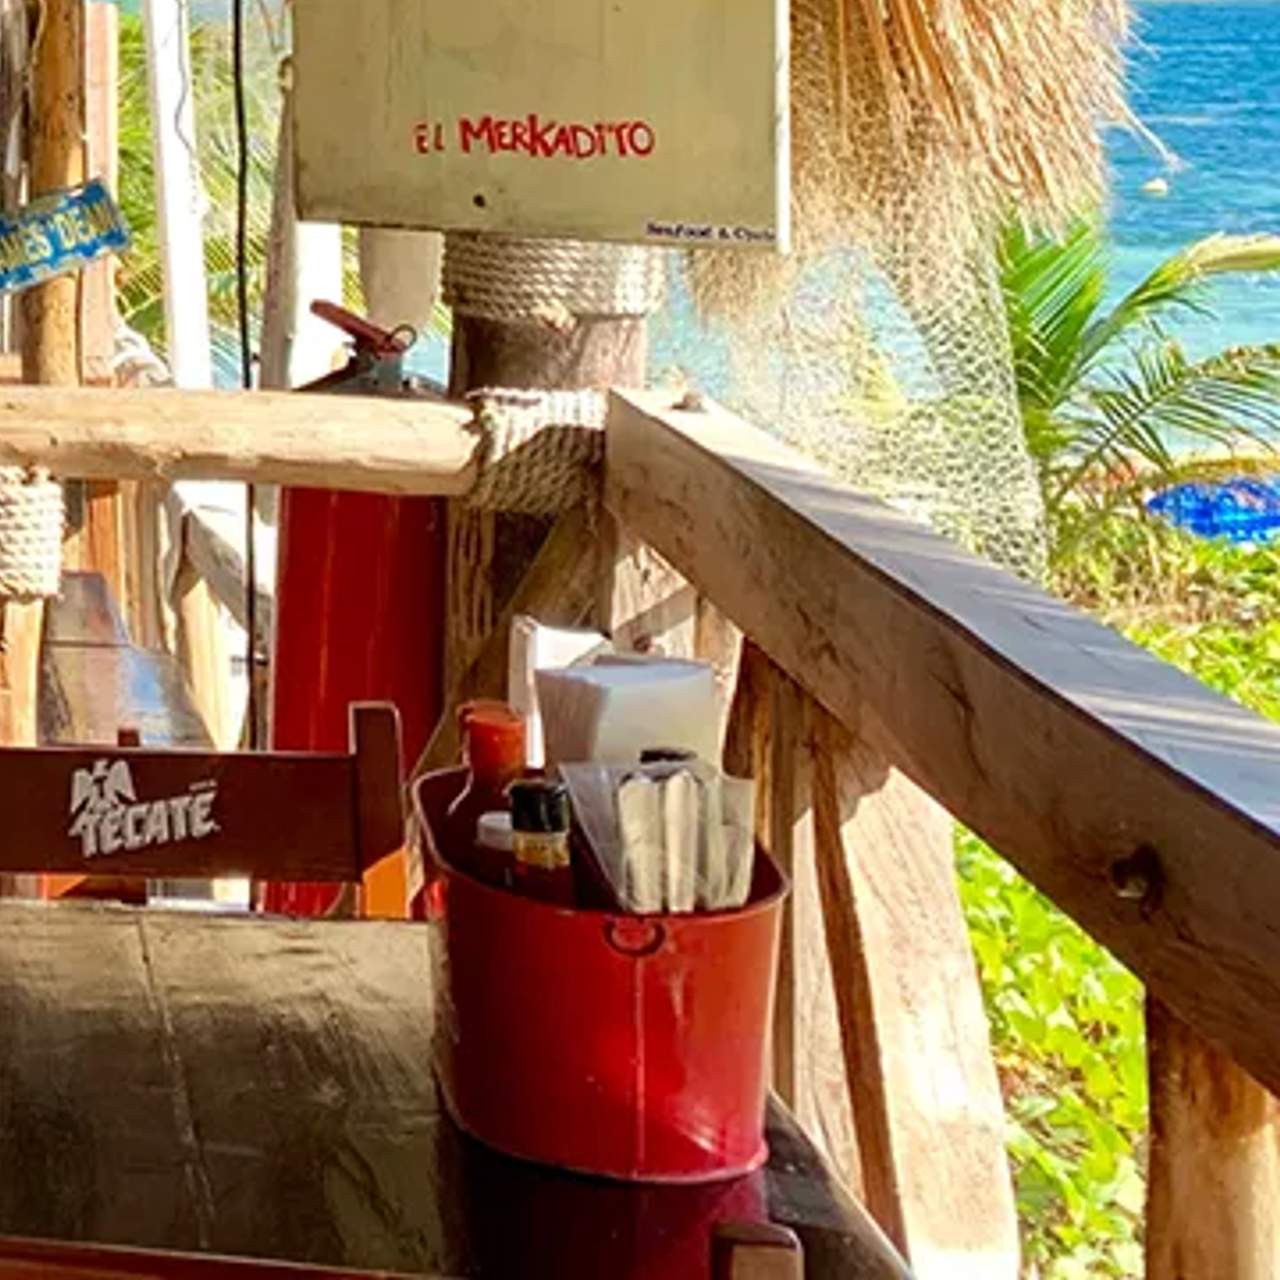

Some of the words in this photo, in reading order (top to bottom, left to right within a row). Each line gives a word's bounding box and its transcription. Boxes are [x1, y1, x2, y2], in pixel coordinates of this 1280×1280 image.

[416, 122, 444, 154] EL
[458, 114, 656, 158] MERKADITO
[67, 779, 222, 858] TECATE
